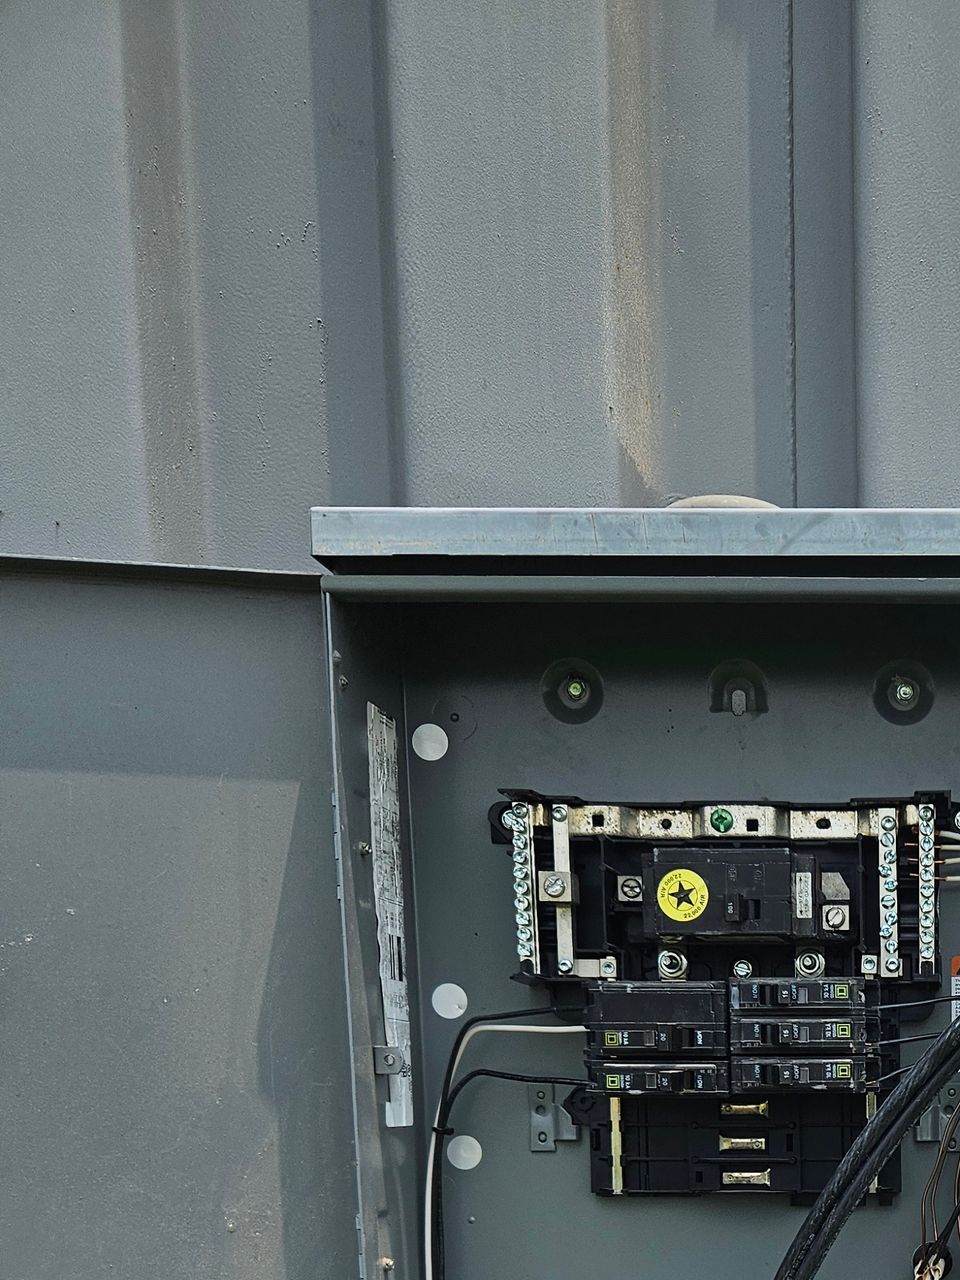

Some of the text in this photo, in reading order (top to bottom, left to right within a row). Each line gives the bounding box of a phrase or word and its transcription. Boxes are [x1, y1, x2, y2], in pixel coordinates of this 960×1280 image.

[782, 990, 789, 999] 15
[660, 1033, 667, 1041] 20
[783, 1029, 789, 1038] 15
[662, 1077, 668, 1086] 20
